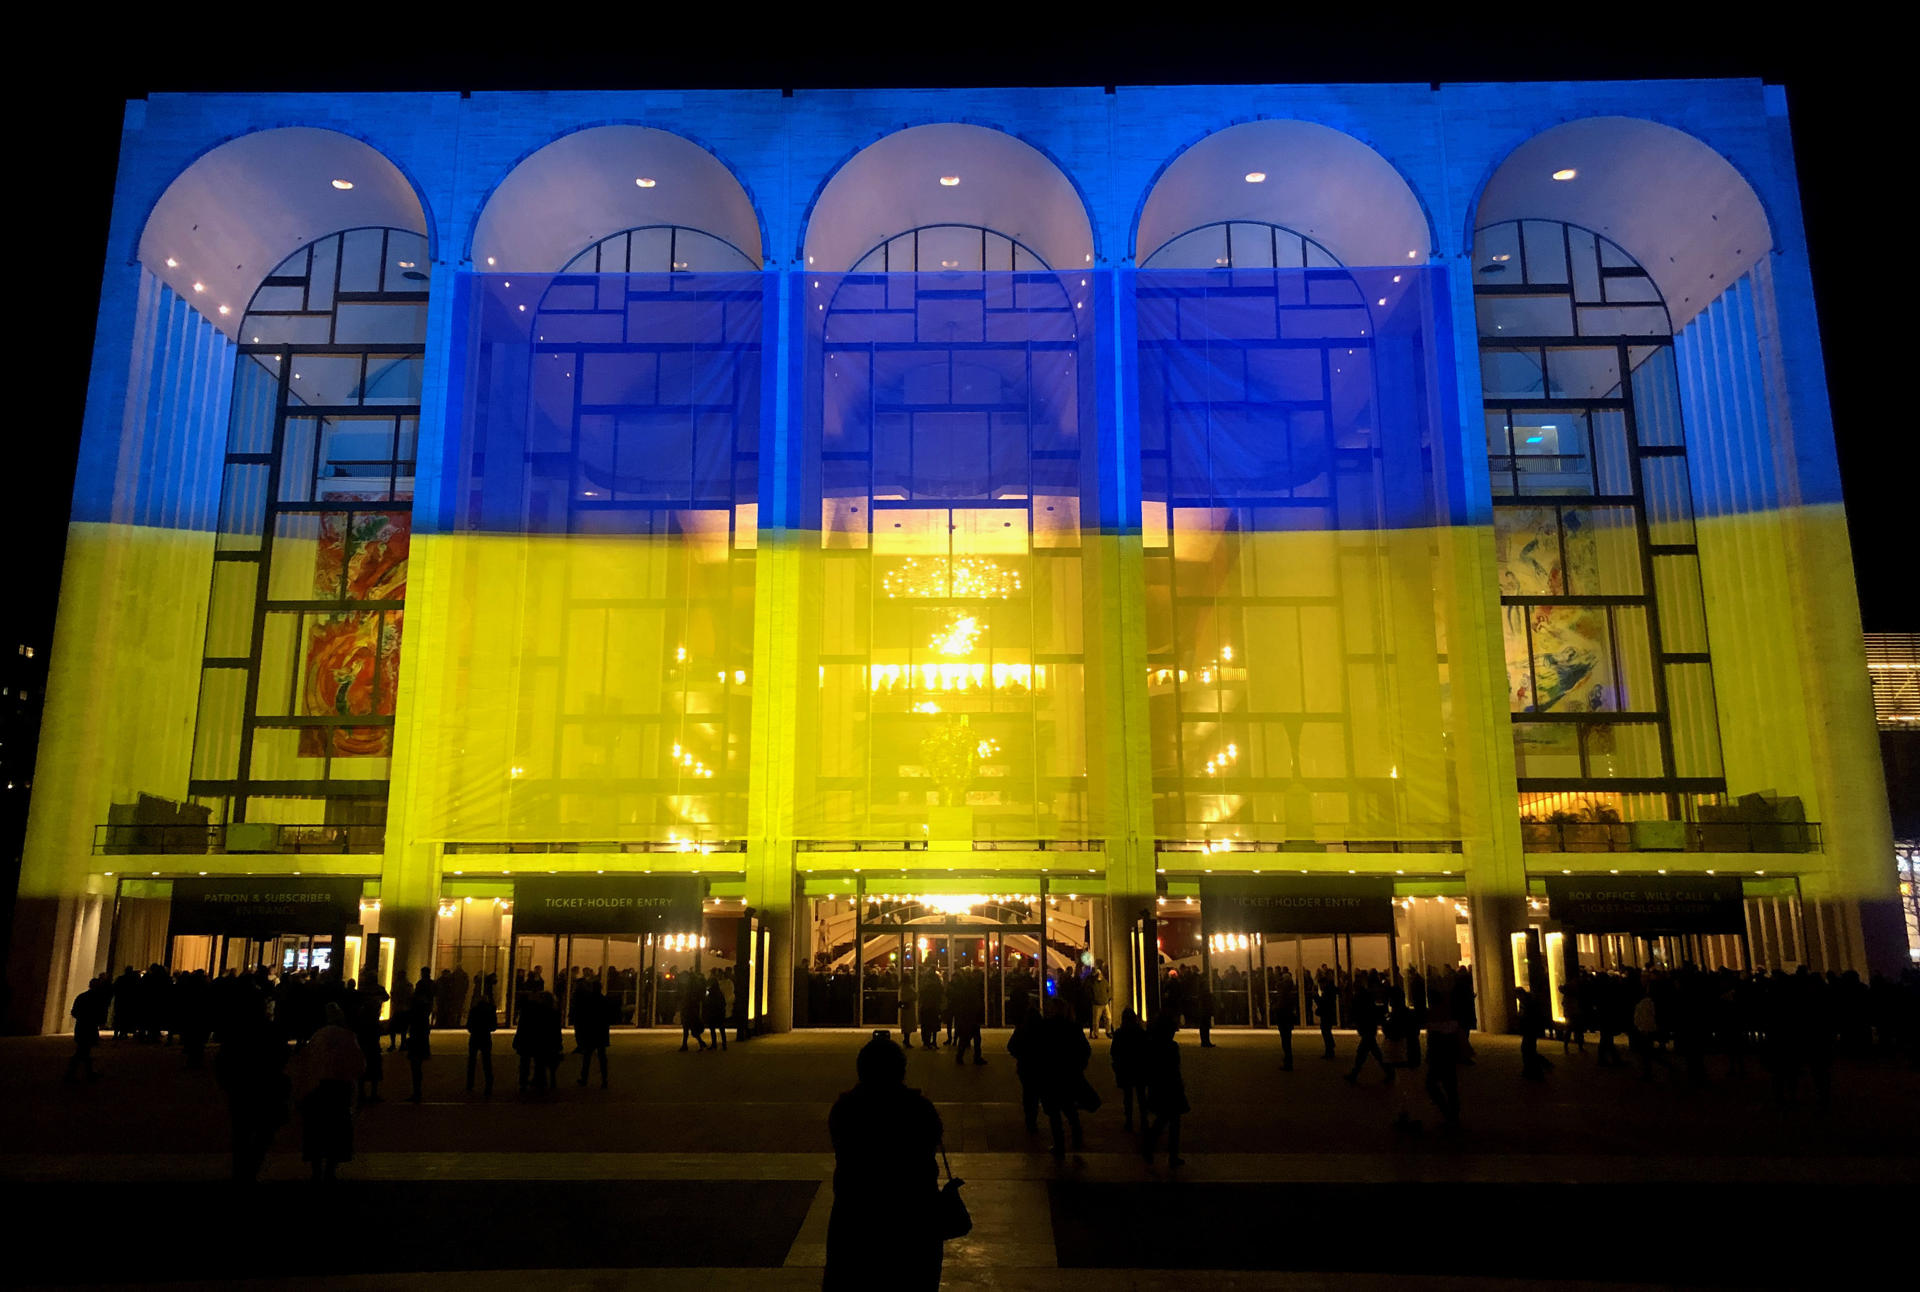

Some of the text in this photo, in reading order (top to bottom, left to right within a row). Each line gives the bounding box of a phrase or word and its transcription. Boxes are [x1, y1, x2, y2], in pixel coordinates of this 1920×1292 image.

[204, 893, 331, 903] PATRON & SUBSCRIBER
[1568, 891, 1592, 901] BOX
[1643, 891, 1671, 901] WILL
[1676, 891, 1704, 901] CALL
[545, 898, 673, 907] TICKET-HOLDER ENTRY
[1232, 897, 1361, 907] TICKET-HOLDER ENTRY
